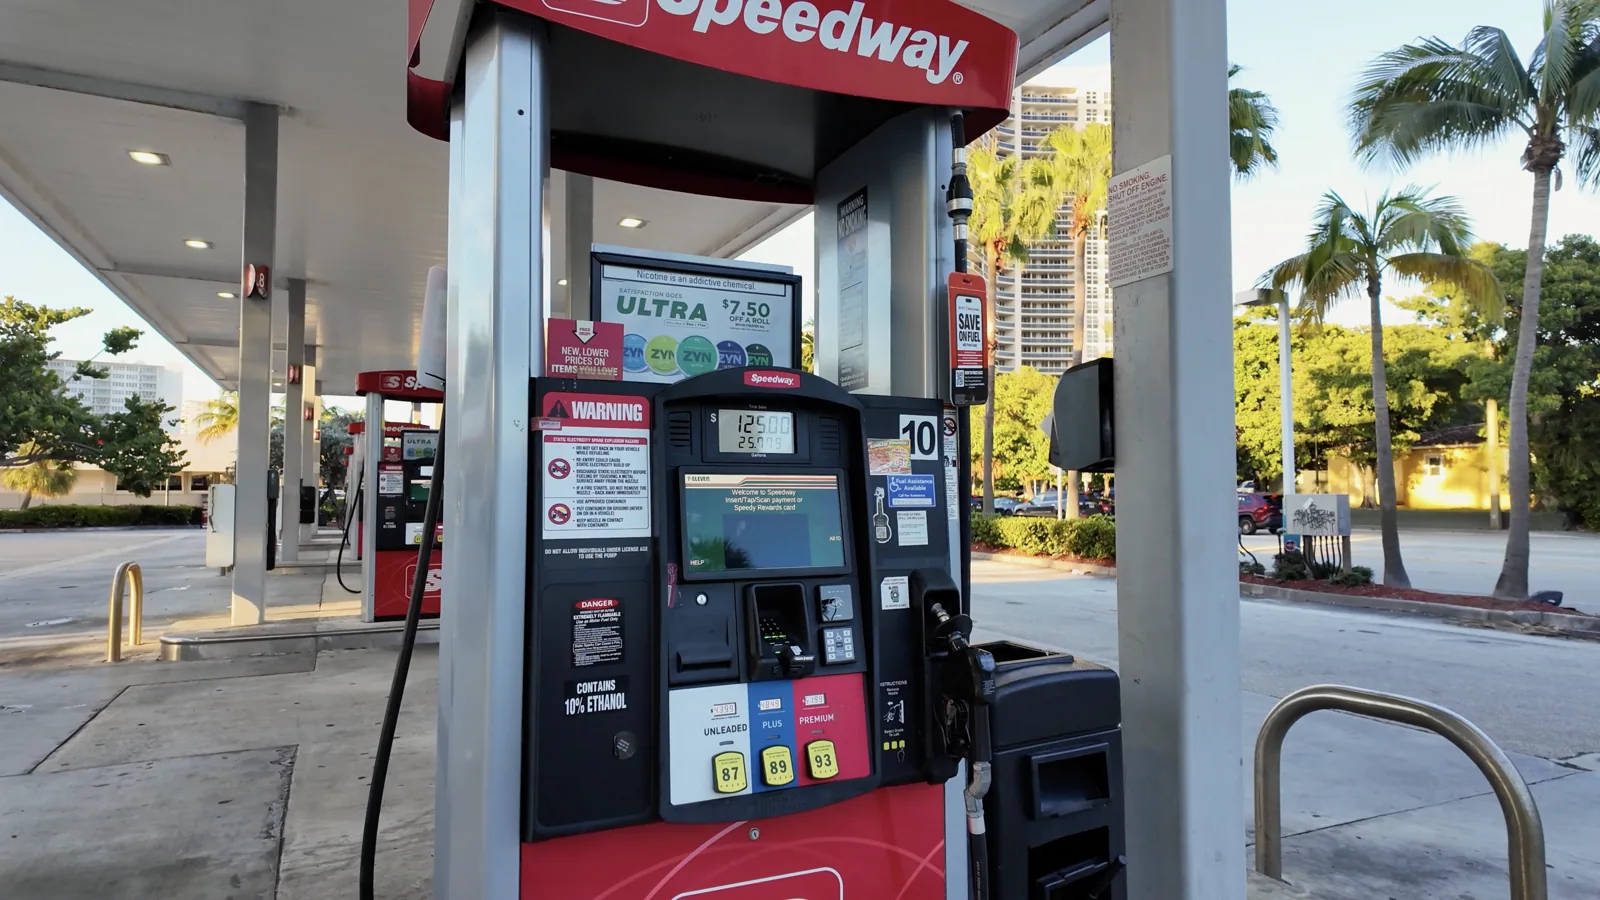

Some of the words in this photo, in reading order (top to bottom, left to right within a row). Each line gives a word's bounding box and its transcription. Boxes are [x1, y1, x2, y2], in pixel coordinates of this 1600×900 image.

[1108, 184, 1118, 194] NO
[1108, 190, 1125, 203] SHUT
[1126, 184, 1140, 196] OFF
[636, 270, 668, 281] Nicotine
[670, 273, 676, 282] is
[688, 276, 722, 287] addictive
[723, 279, 756, 290] chemical.
[619, 288, 664, 297] SATISFACTION
[617, 295, 707, 321] ULTRA
[722, 299, 770, 318] $7.50
[959, 313, 980, 330] SAVE
[959, 330, 967, 341] ON
[968, 331, 980, 342] FUEL
[562, 346, 581, 356] NEW,
[583, 348, 609, 357] LOWER
[683, 350, 712, 363] ZYN
[565, 356, 592, 365] PRICES
[594, 358, 605, 366] ON
[719, 354, 741, 364] ZYN
[552, 364, 577, 373] ITEMS
[578, 366, 596, 375] YOU
[597, 367, 618, 376] LOVE
[751, 374, 794, 385] Speedway
[572, 401, 642, 421] WARNING
[710, 413, 716, 422] $
[902, 420, 936, 455] 10
[582, 600, 613, 608] DANGER
[576, 679, 616, 694] CONTAINS
[565, 697, 585, 715] 10%
[587, 692, 626, 712] ETHANOL
[763, 720, 782, 729] PLUS
[799, 714, 834, 724] PREMIUM
[704, 724, 748, 736] UNLEADED
[770, 760, 786, 774] 89
[815, 754, 832, 768] 93
[722, 767, 739, 782] 87
